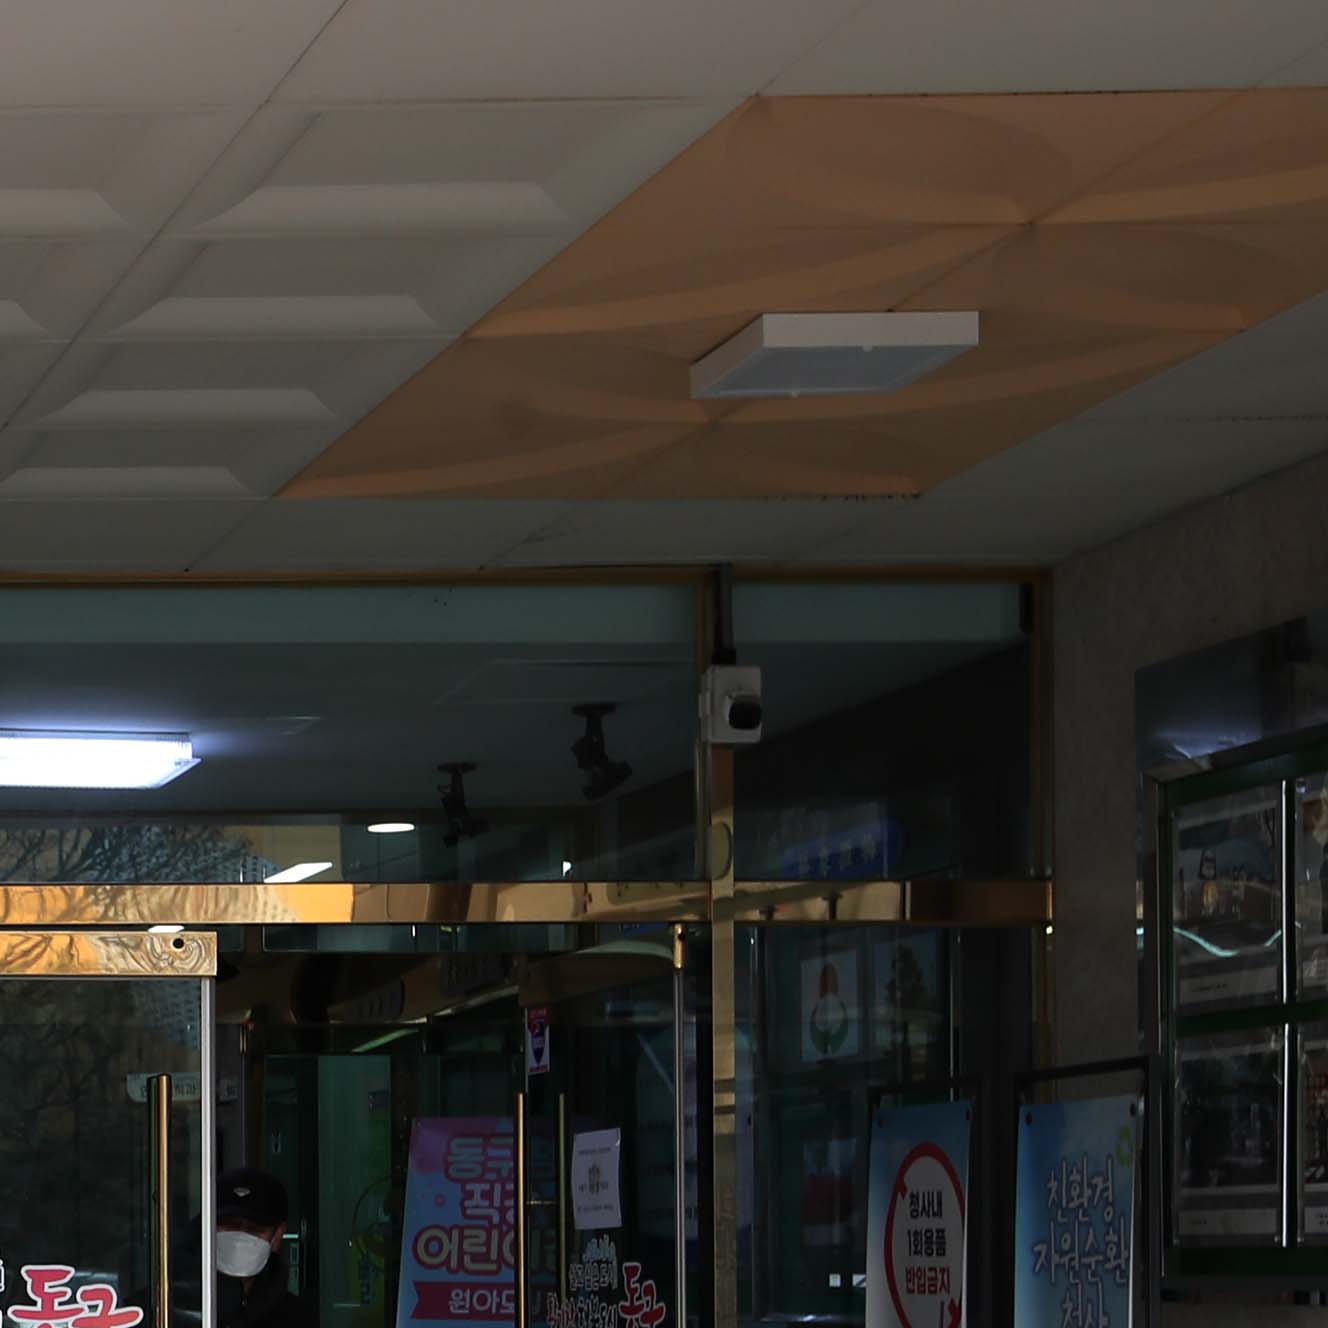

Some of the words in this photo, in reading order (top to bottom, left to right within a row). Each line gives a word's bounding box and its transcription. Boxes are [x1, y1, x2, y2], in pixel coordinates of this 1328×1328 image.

[1047, 1152, 1113, 1223] 친환경
[910, 1191, 942, 1219] 청사내
[908, 1228, 946, 1256] 1회용품
[1033, 1214, 1129, 1286] 자원순환
[906, 1266, 950, 1294] 반입금지
